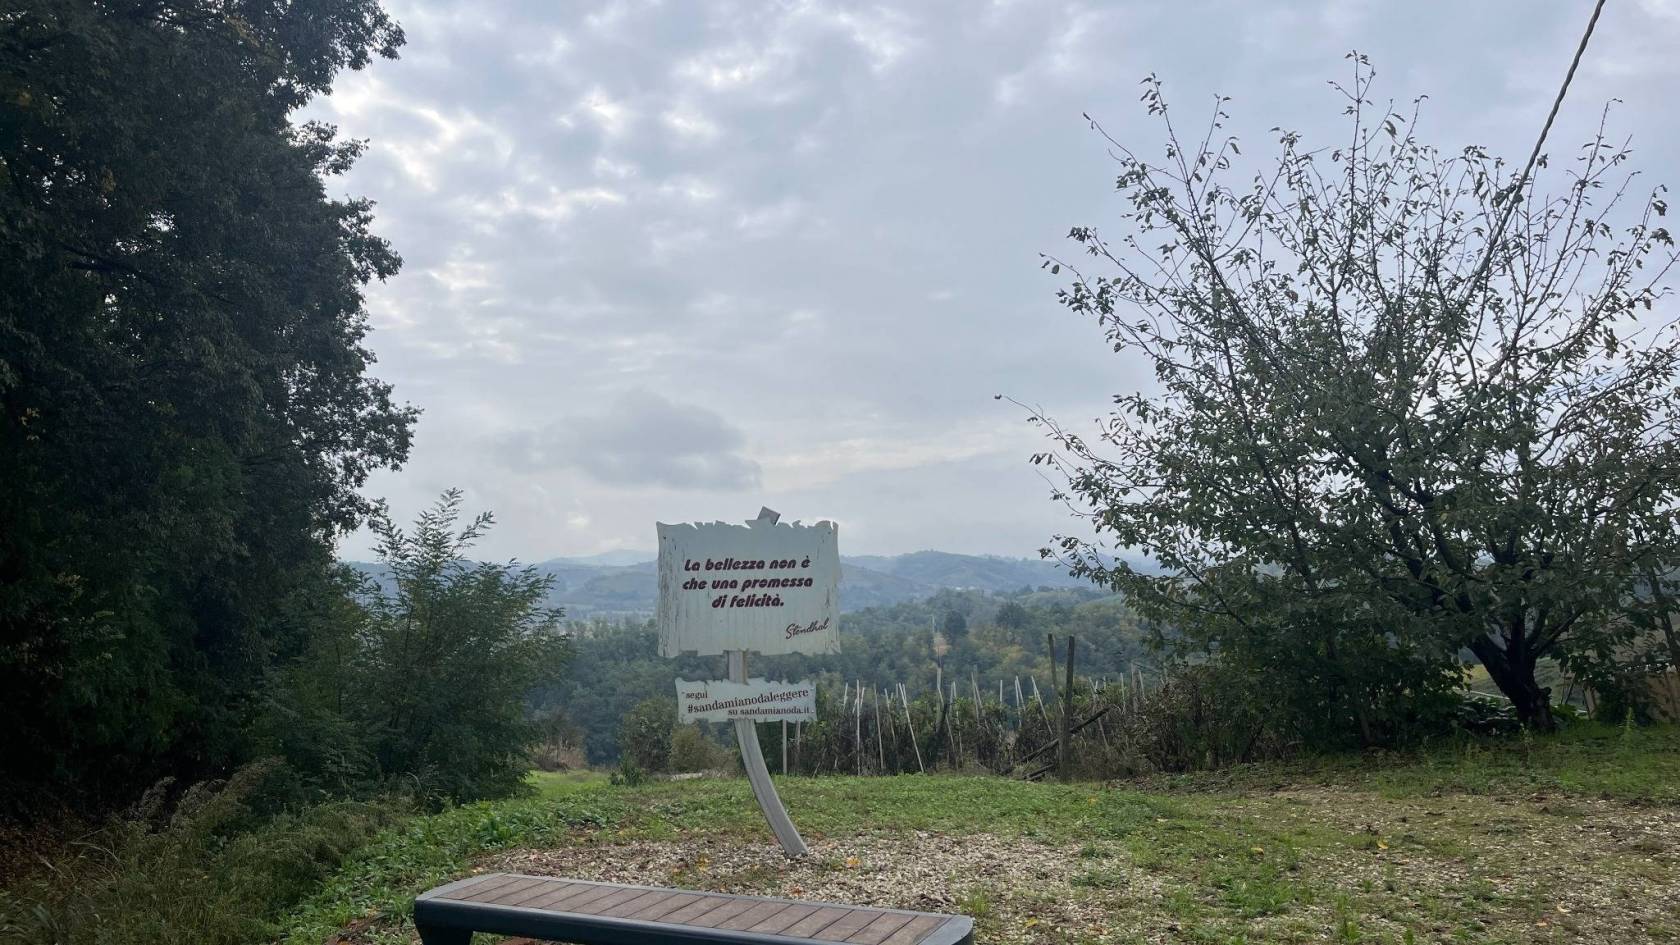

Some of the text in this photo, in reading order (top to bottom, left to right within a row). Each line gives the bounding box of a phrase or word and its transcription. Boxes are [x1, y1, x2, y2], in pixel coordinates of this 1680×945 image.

[684, 555, 811, 571] La bellezza non è
[682, 577, 813, 592] che una promessa
[712, 593, 784, 608] di felicità.
[785, 617, 829, 639] Stendhal
[686, 690, 708, 700] segui
[688, 689, 809, 713] #sandamianodaleggere
